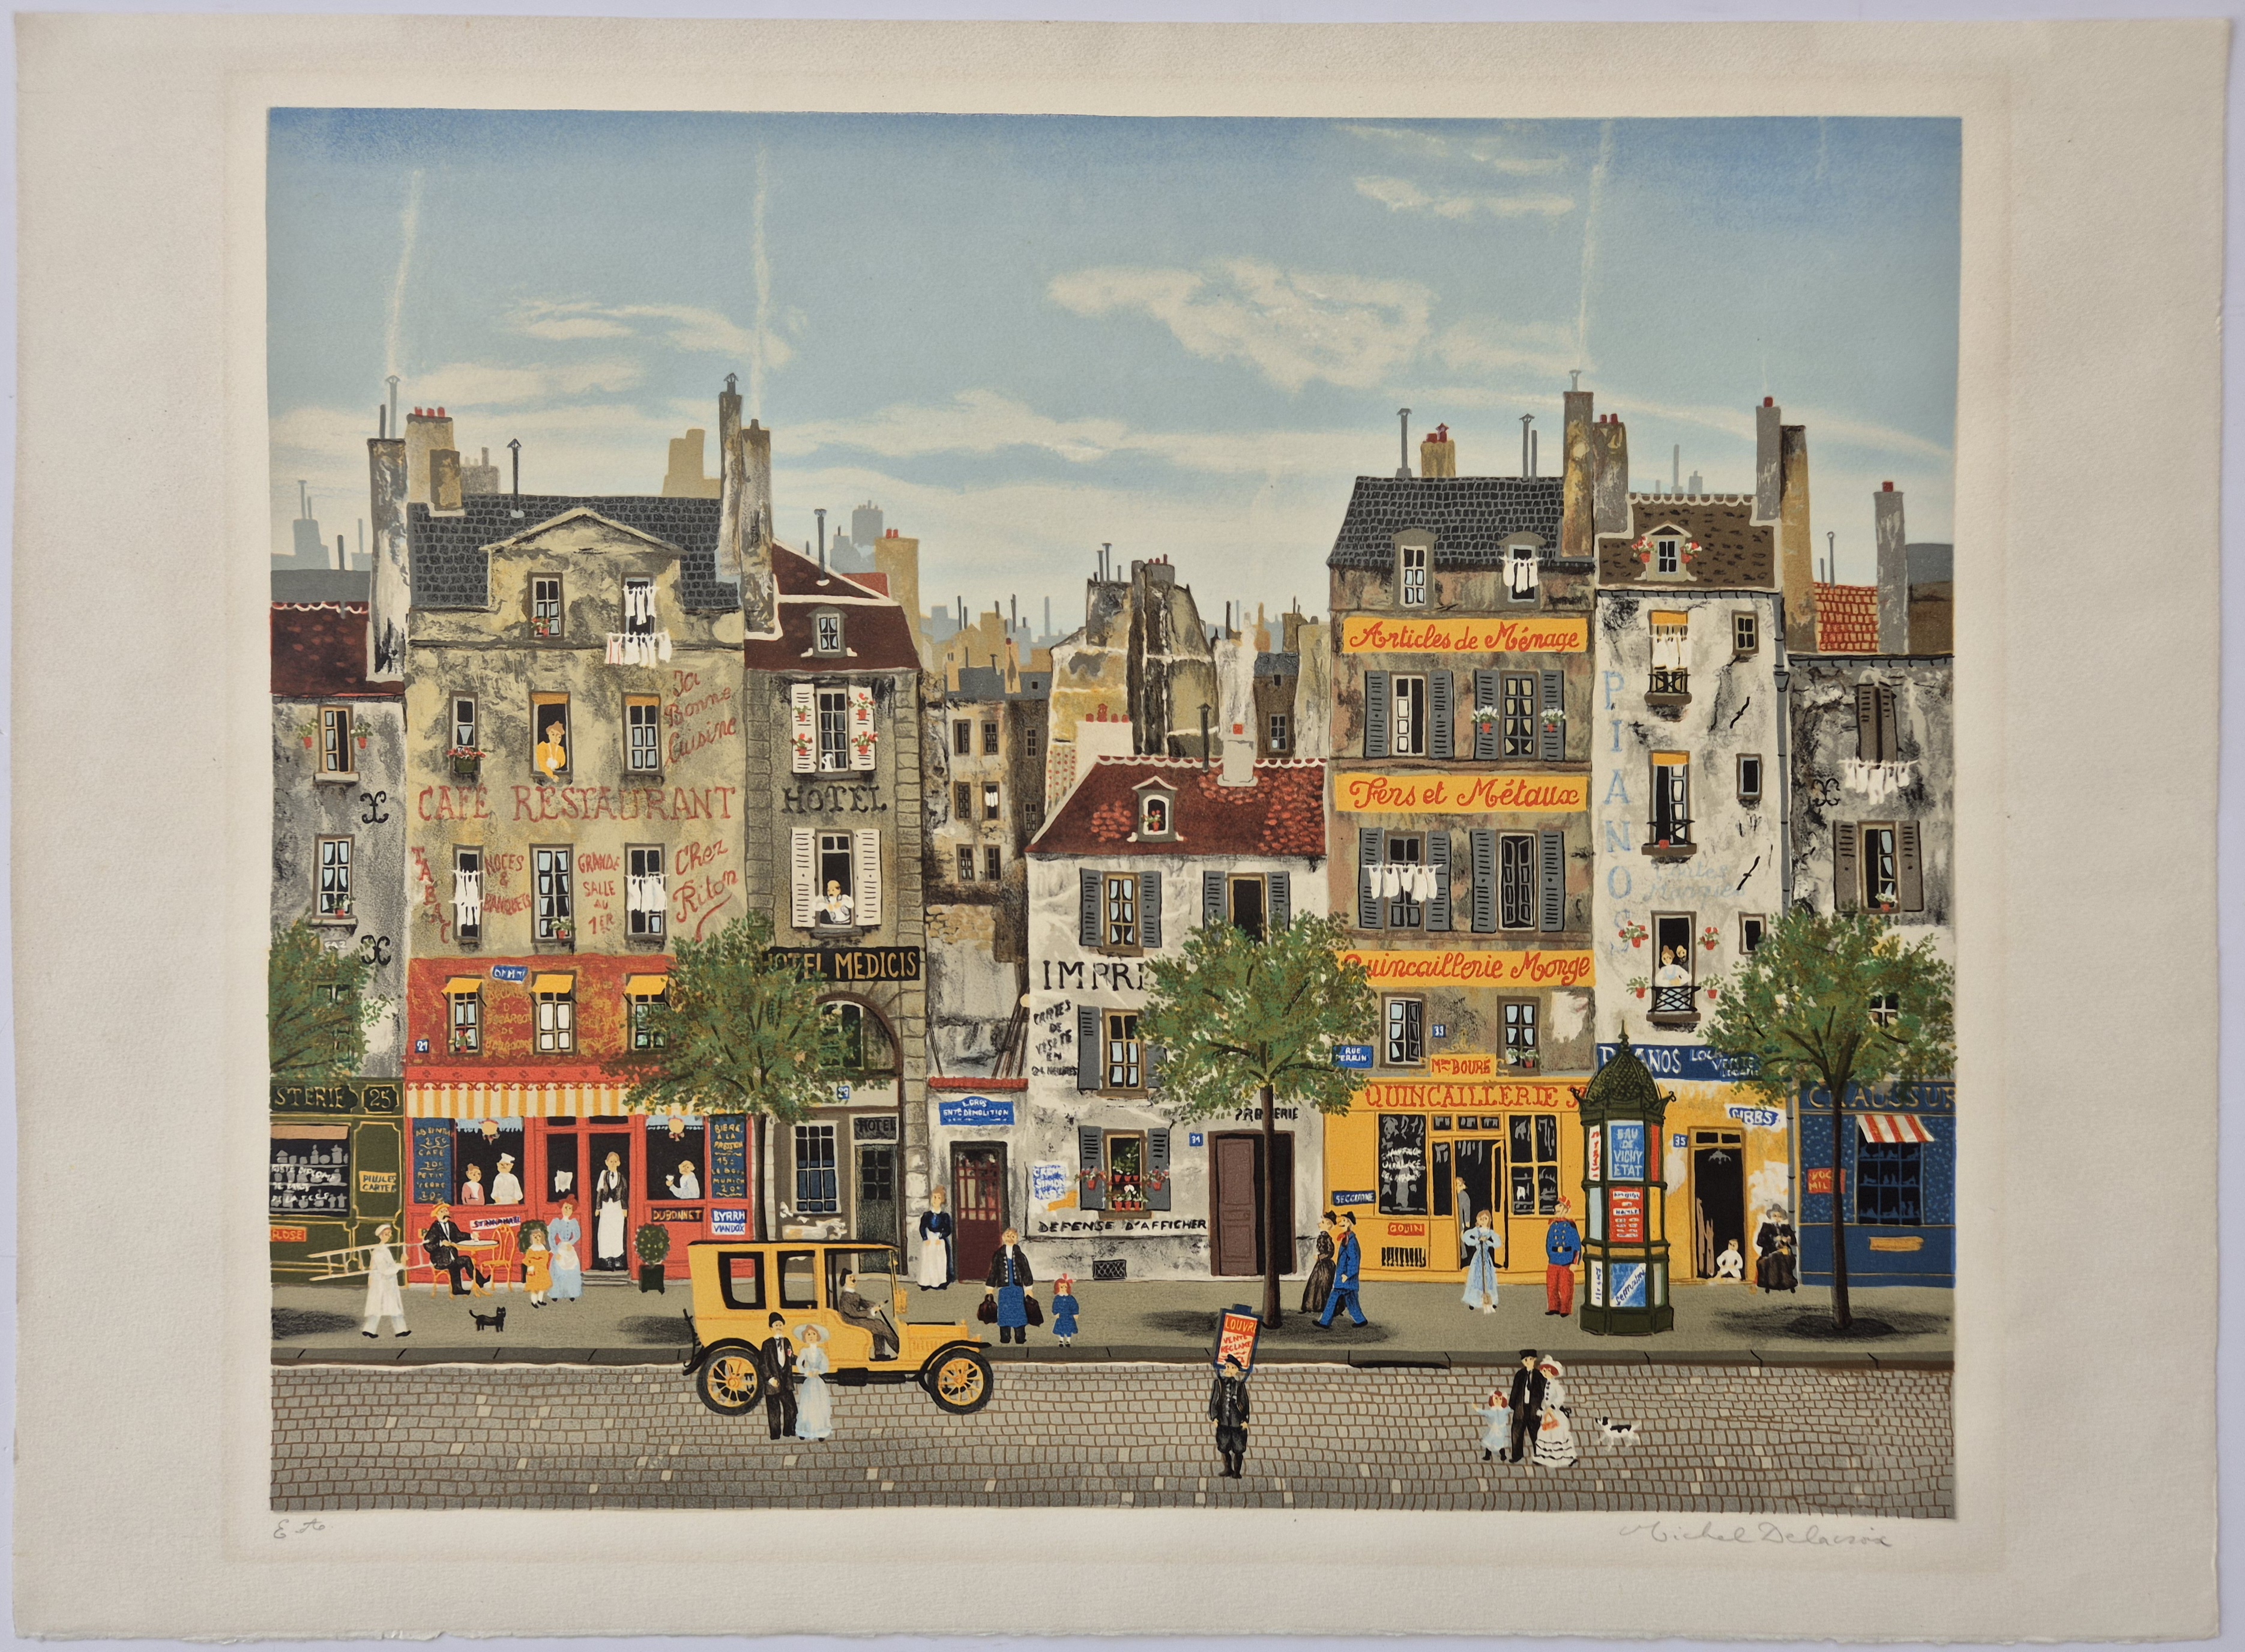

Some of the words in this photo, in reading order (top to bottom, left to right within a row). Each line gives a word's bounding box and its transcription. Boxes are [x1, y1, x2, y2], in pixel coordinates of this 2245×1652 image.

[1349, 621, 1451, 649] Articles
[1454, 626, 1478, 651] de
[1484, 621, 1580, 653] Ménage
[664, 687, 731, 729] Bonne
[664, 717, 737, 768] Cuisine
[512, 785, 736, 822] RESTAURANT
[781, 785, 887, 813] HOTEL
[1349, 777, 1416, 809] Fers
[1423, 781, 1448, 804] et
[1457, 777, 1580, 808] Métaux
[484, 853, 525, 876] NOCES
[578, 851, 621, 873] GRANDE
[675, 839, 728, 876] Chez
[499, 872, 508, 888] &
[583, 880, 616, 897] SALLE
[411, 846, 451, 944] TABAC
[483, 893, 532, 916] BANQUETS
[594, 899, 609, 910] AU
[672, 870, 739, 923] Riton
[835, 951, 917, 980] MEDICIS
[1510, 951, 1591, 987] Monge
[1049, 1022, 1062, 1033] DE
[1434, 1026, 1444, 1037] 33
[417, 1041, 427, 1052] 21
[1599, 1046, 1681, 1073] PANOS
[369, 1088, 391, 1109] 25
[1365, 1084, 1558, 1109] QUINCAILLERIE
[857, 1119, 896, 1132] HOTEL
[1617, 1128, 1638, 1140] EAU
[1192, 1136, 1201, 1144] 31
[1622, 1140, 1633, 1149] DE
[1675, 1136, 1686, 1146] 35
[1614, 1164, 1643, 1177] ETAT
[653, 1210, 703, 1220] DUBONNET
[714, 1210, 745, 1222] BYRRH
[1125, 1219, 1207, 1231] D'AFFICHER
[714, 1225, 744, 1233] VIANDOX
[1223, 1334, 1248, 1345] VENTE
[1619, 1521, 1753, 1543] Michel
[1758, 1522, 1893, 1547] Delacroix
